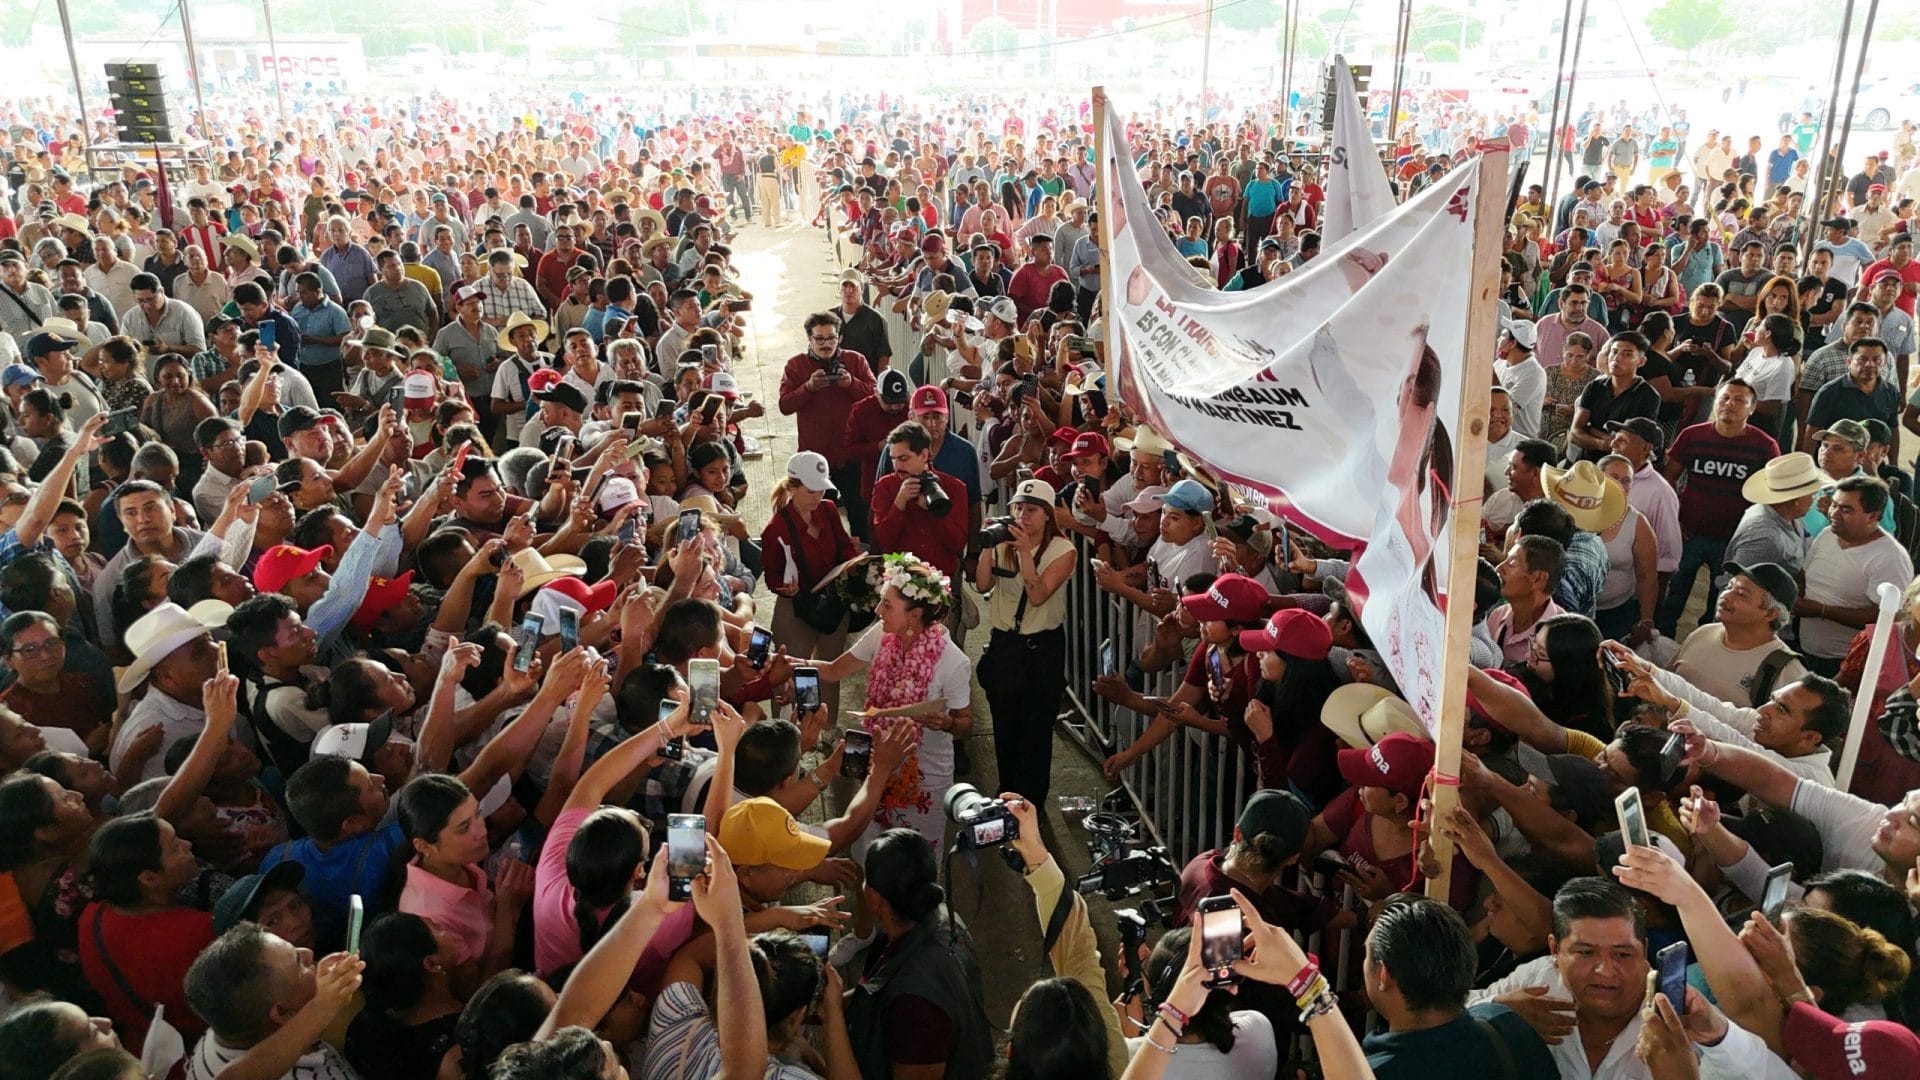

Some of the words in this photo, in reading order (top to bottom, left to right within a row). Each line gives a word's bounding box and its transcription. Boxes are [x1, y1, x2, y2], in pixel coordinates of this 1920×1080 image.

[1136, 309, 1159, 333] ES
[1150, 323, 1182, 356] CON
[892, 382, 903, 393] C
[1023, 483, 1034, 494] C
